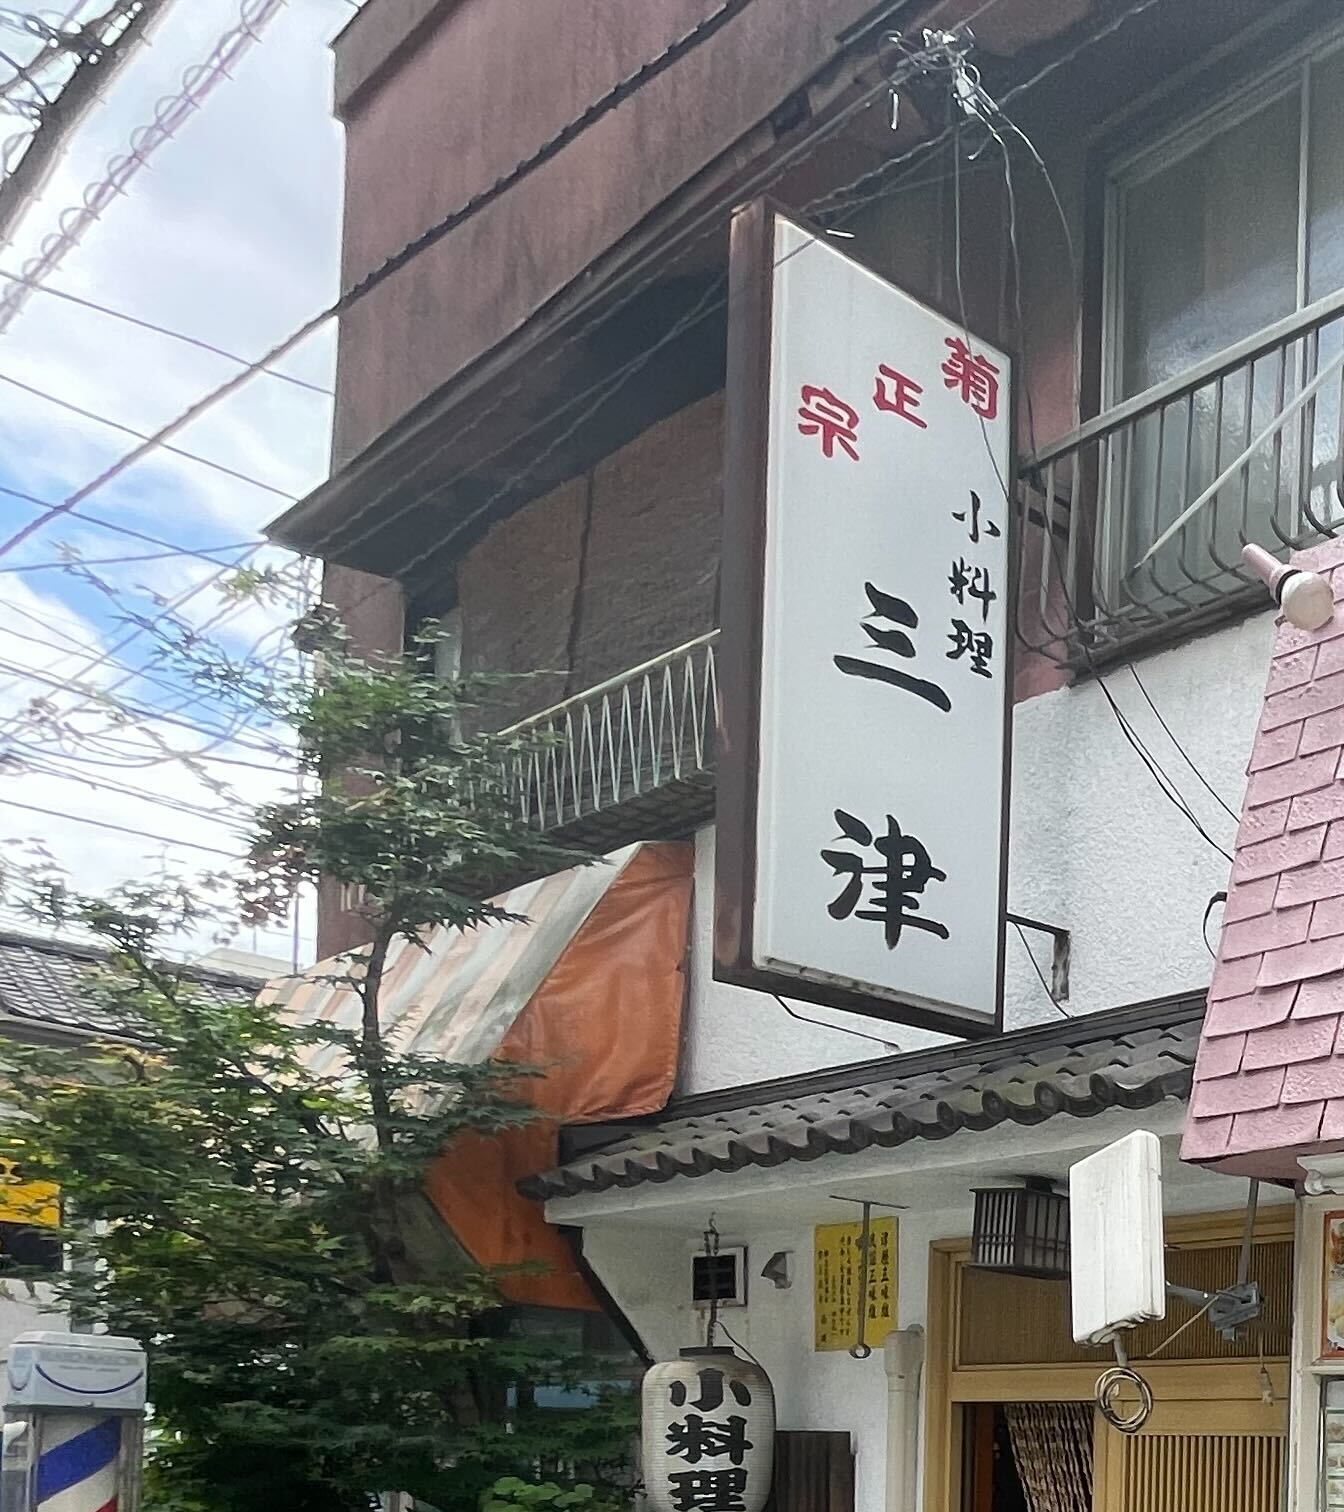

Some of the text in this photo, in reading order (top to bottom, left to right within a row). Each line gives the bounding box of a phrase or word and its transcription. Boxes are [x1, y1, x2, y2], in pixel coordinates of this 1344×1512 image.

[946, 489, 1000, 680] 小料理
[821, 580, 953, 951] 三津
